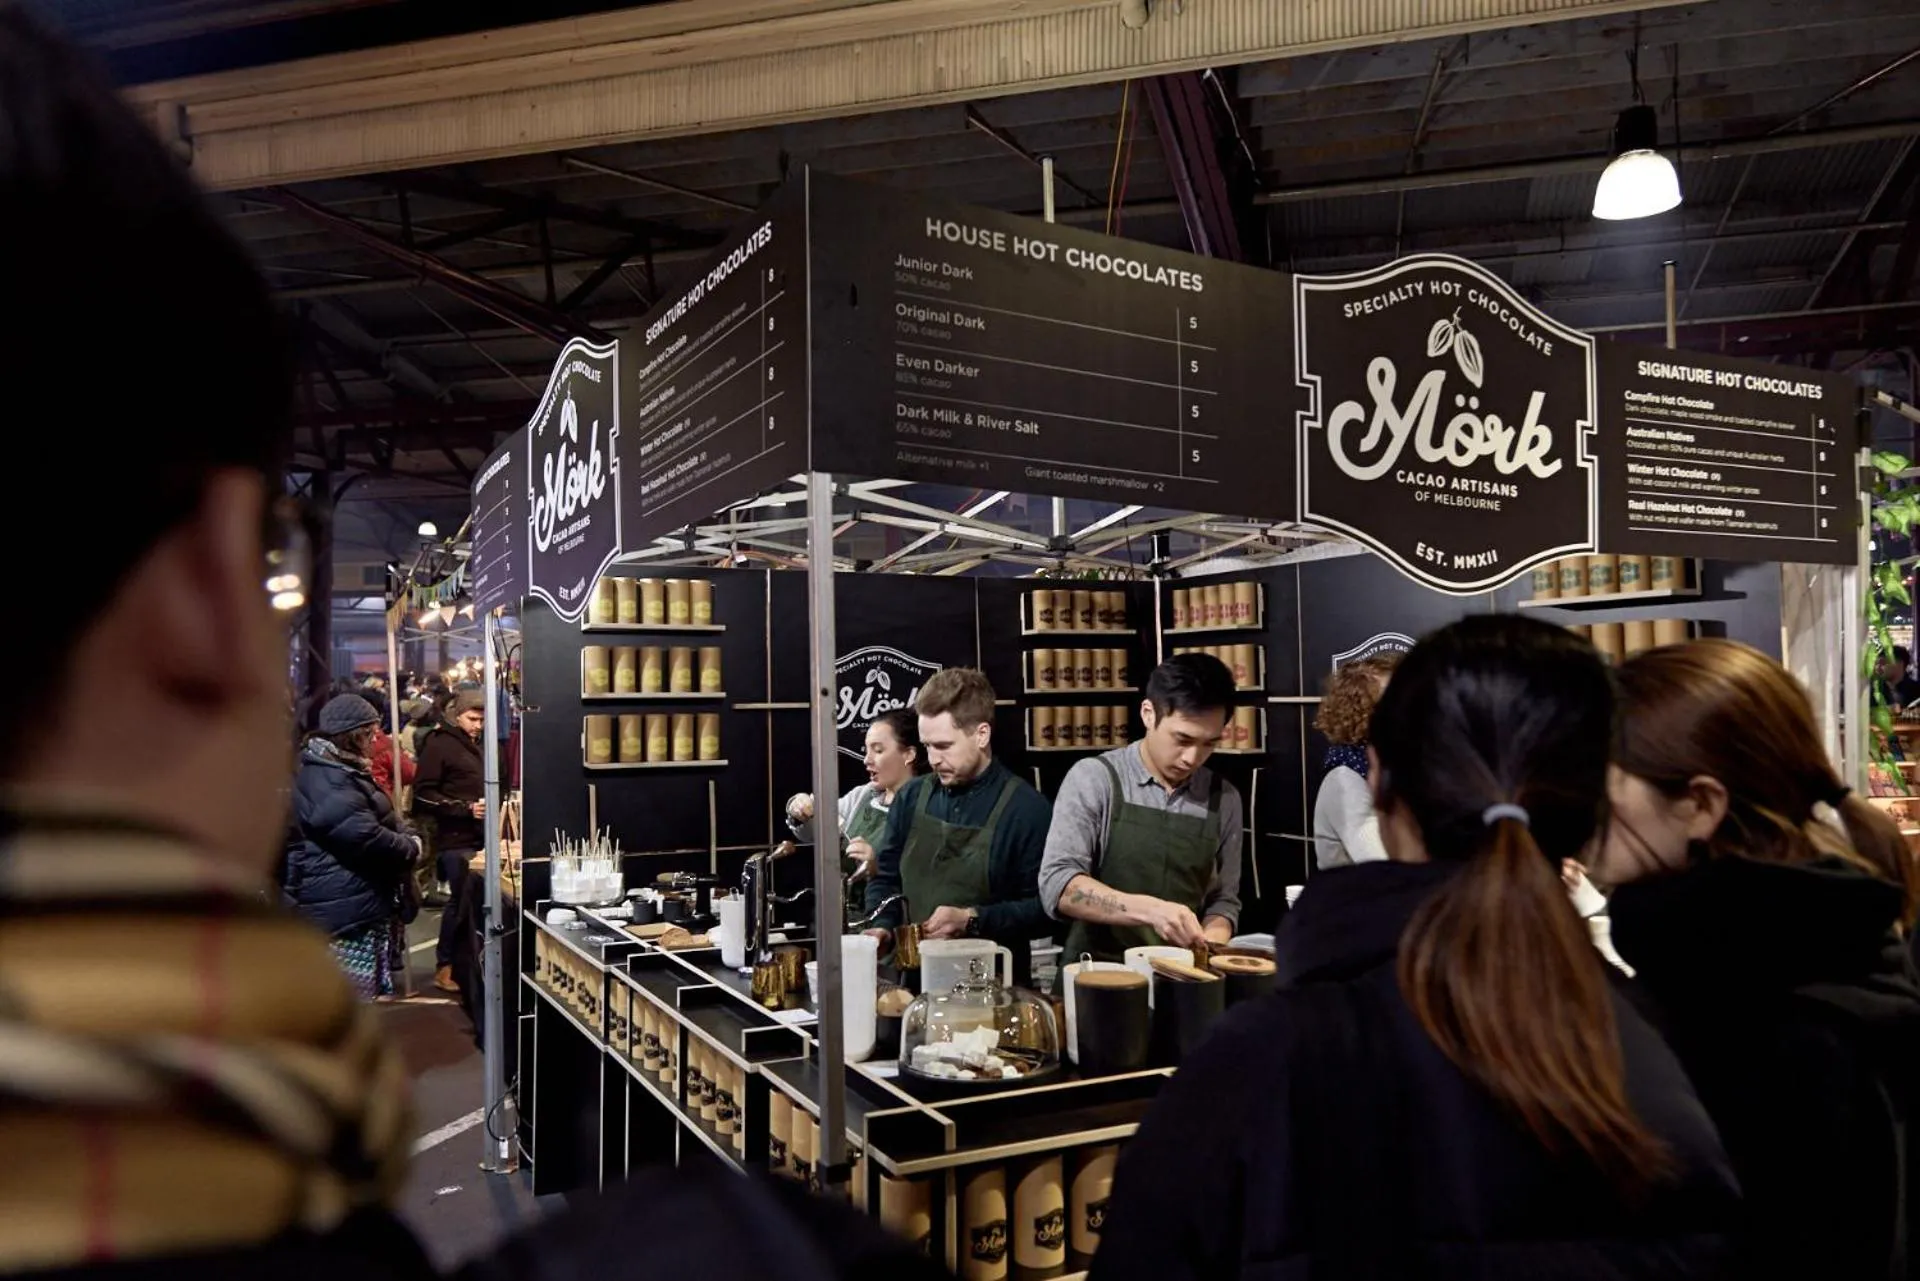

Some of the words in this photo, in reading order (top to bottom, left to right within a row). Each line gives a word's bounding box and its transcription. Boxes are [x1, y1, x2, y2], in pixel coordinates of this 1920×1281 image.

[926, 217, 1006, 252] HOUSE
[1013, 235, 1059, 263] HOT
[1065, 248, 1204, 293] CHOCOLATES
[768, 267, 775, 283] 8
[894, 253, 939, 273] Junior
[941, 262, 974, 281] Dark
[645, 294, 688, 346] SIGNATURE
[687, 277, 707, 309] HOT
[706, 220, 773, 292] CHOCOLATES
[768, 316, 775, 332] 8
[895, 302, 951, 325] Original
[953, 311, 986, 331] Dark
[1189, 316, 1198, 329] 5
[1343, 280, 1425, 319] SPECIALTY
[1429, 279, 1462, 297] HOT
[1467, 287, 1554, 357] CHOCOLATE
[571, 359, 602, 384] CHOCOLATE
[768, 365, 775, 381] 8
[895, 353, 930, 370] Even
[933, 359, 981, 378] Darker
[1190, 360, 1199, 374] 5
[1637, 360, 1714, 385] SIGNATURE
[1715, 370, 1743, 388] HOT
[1744, 376, 1823, 400] CHOCOLATES
[1191, 405, 1200, 418] 5
[1661, 394, 1675, 405] Hot
[1676, 396, 1714, 409] Chocolate
[768, 415, 775, 431] 8
[895, 402, 930, 420] Dark
[932, 408, 961, 424] Milk
[963, 413, 974, 426] &
[976, 414, 1012, 430] River
[1014, 419, 1041, 436] Salt
[1327, 355, 1563, 481] Mörk
[1626, 427, 1665, 439] Australian
[1665, 431, 1695, 442] Natives
[896, 450, 955, 468] Alternative
[956, 457, 977, 470] milk
[1191, 450, 1200, 463] 5
[1024, 465, 1050, 479] Giant
[1052, 469, 1088, 484] toasted
[1089, 475, 1150, 491] marshmallow
[1152, 481, 1166, 493] +2
[1627, 463, 1653, 474] Winter
[1654, 466, 1669, 475] Hot
[1670, 467, 1708, 479] Chocolate
[1395, 469, 1446, 489] CACAO
[1450, 477, 1519, 498] ARTISANS
[1414, 490, 1431, 502] OF
[1434, 492, 1502, 511] MELBOURNE
[1628, 499, 1645, 509] Real
[1646, 501, 1680, 512] Hazelnut
[1681, 504, 1695, 513] Hot
[1695, 504, 1733, 516] Chocolate
[551, 528, 569, 546] CACAO
[1415, 542, 1449, 567] EST.
[1453, 549, 1499, 571] MMXII
[836, 657, 865, 675] PECIALTY
[883, 655, 923, 676] CHOCOLATE
